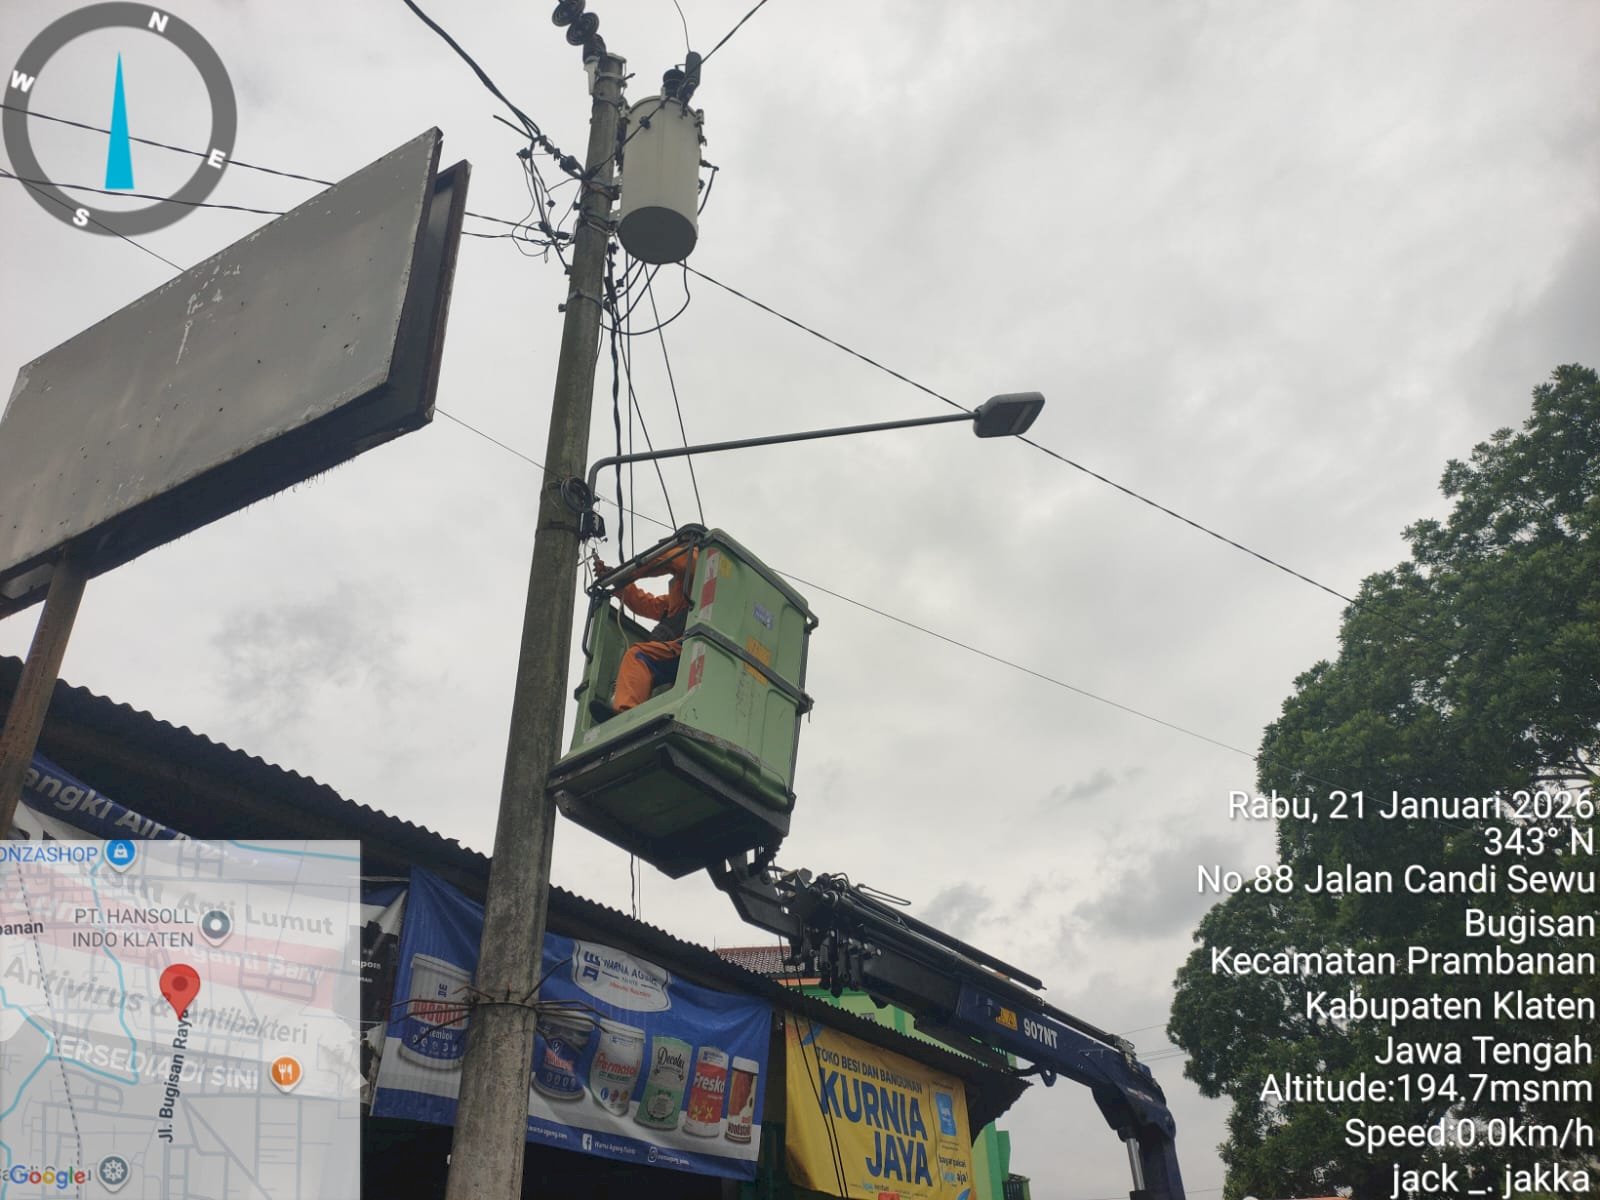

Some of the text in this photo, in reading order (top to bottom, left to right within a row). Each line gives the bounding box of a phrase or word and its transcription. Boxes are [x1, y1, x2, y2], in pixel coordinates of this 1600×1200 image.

[816, 1047, 840, 1067] TOKO
[841, 1056, 861, 1073] BESI
[862, 1063, 879, 1081] DAN
[819, 1067, 929, 1141] KURNIA
[866, 1131, 933, 1187] JAYA
